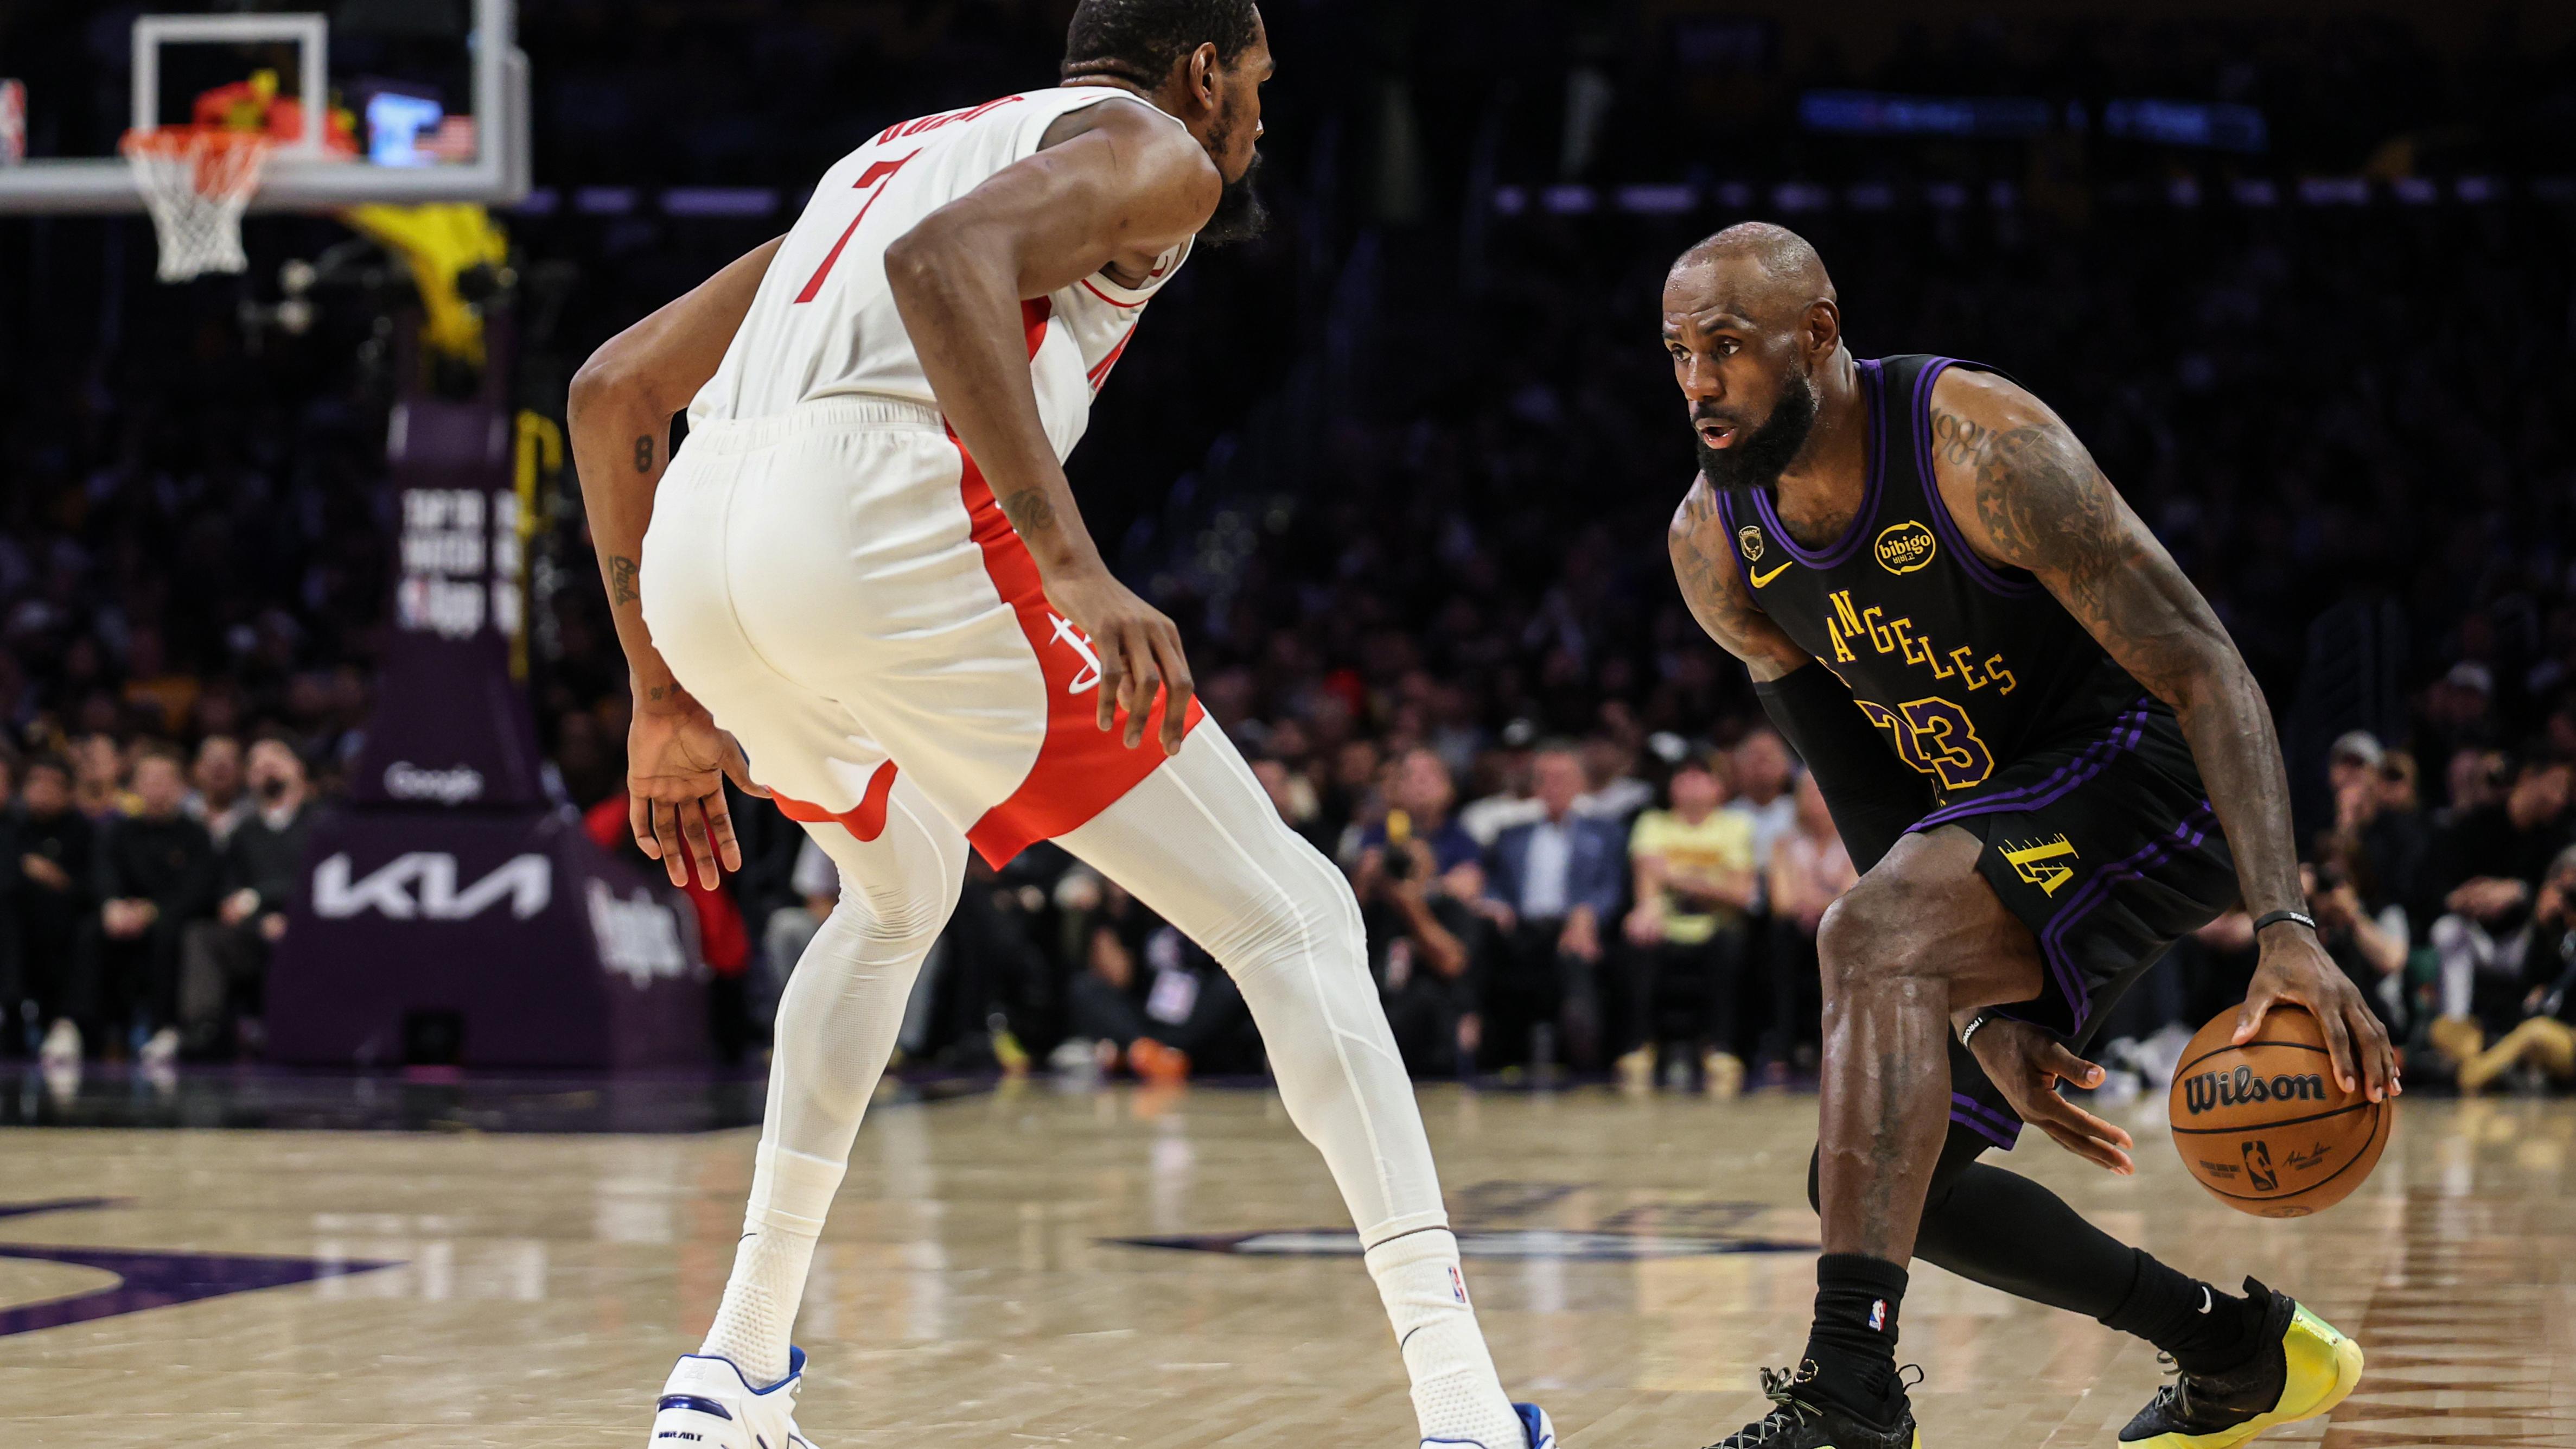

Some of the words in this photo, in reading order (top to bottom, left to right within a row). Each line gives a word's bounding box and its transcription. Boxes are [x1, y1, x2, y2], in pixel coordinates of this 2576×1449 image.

[794, 147, 923, 304] 7
[634, 435, 653, 473] 8
[1879, 535, 1930, 559] bibigo
[1826, 589, 2017, 695] ANGELES
[2184, 1065, 2327, 1116] Wilson
